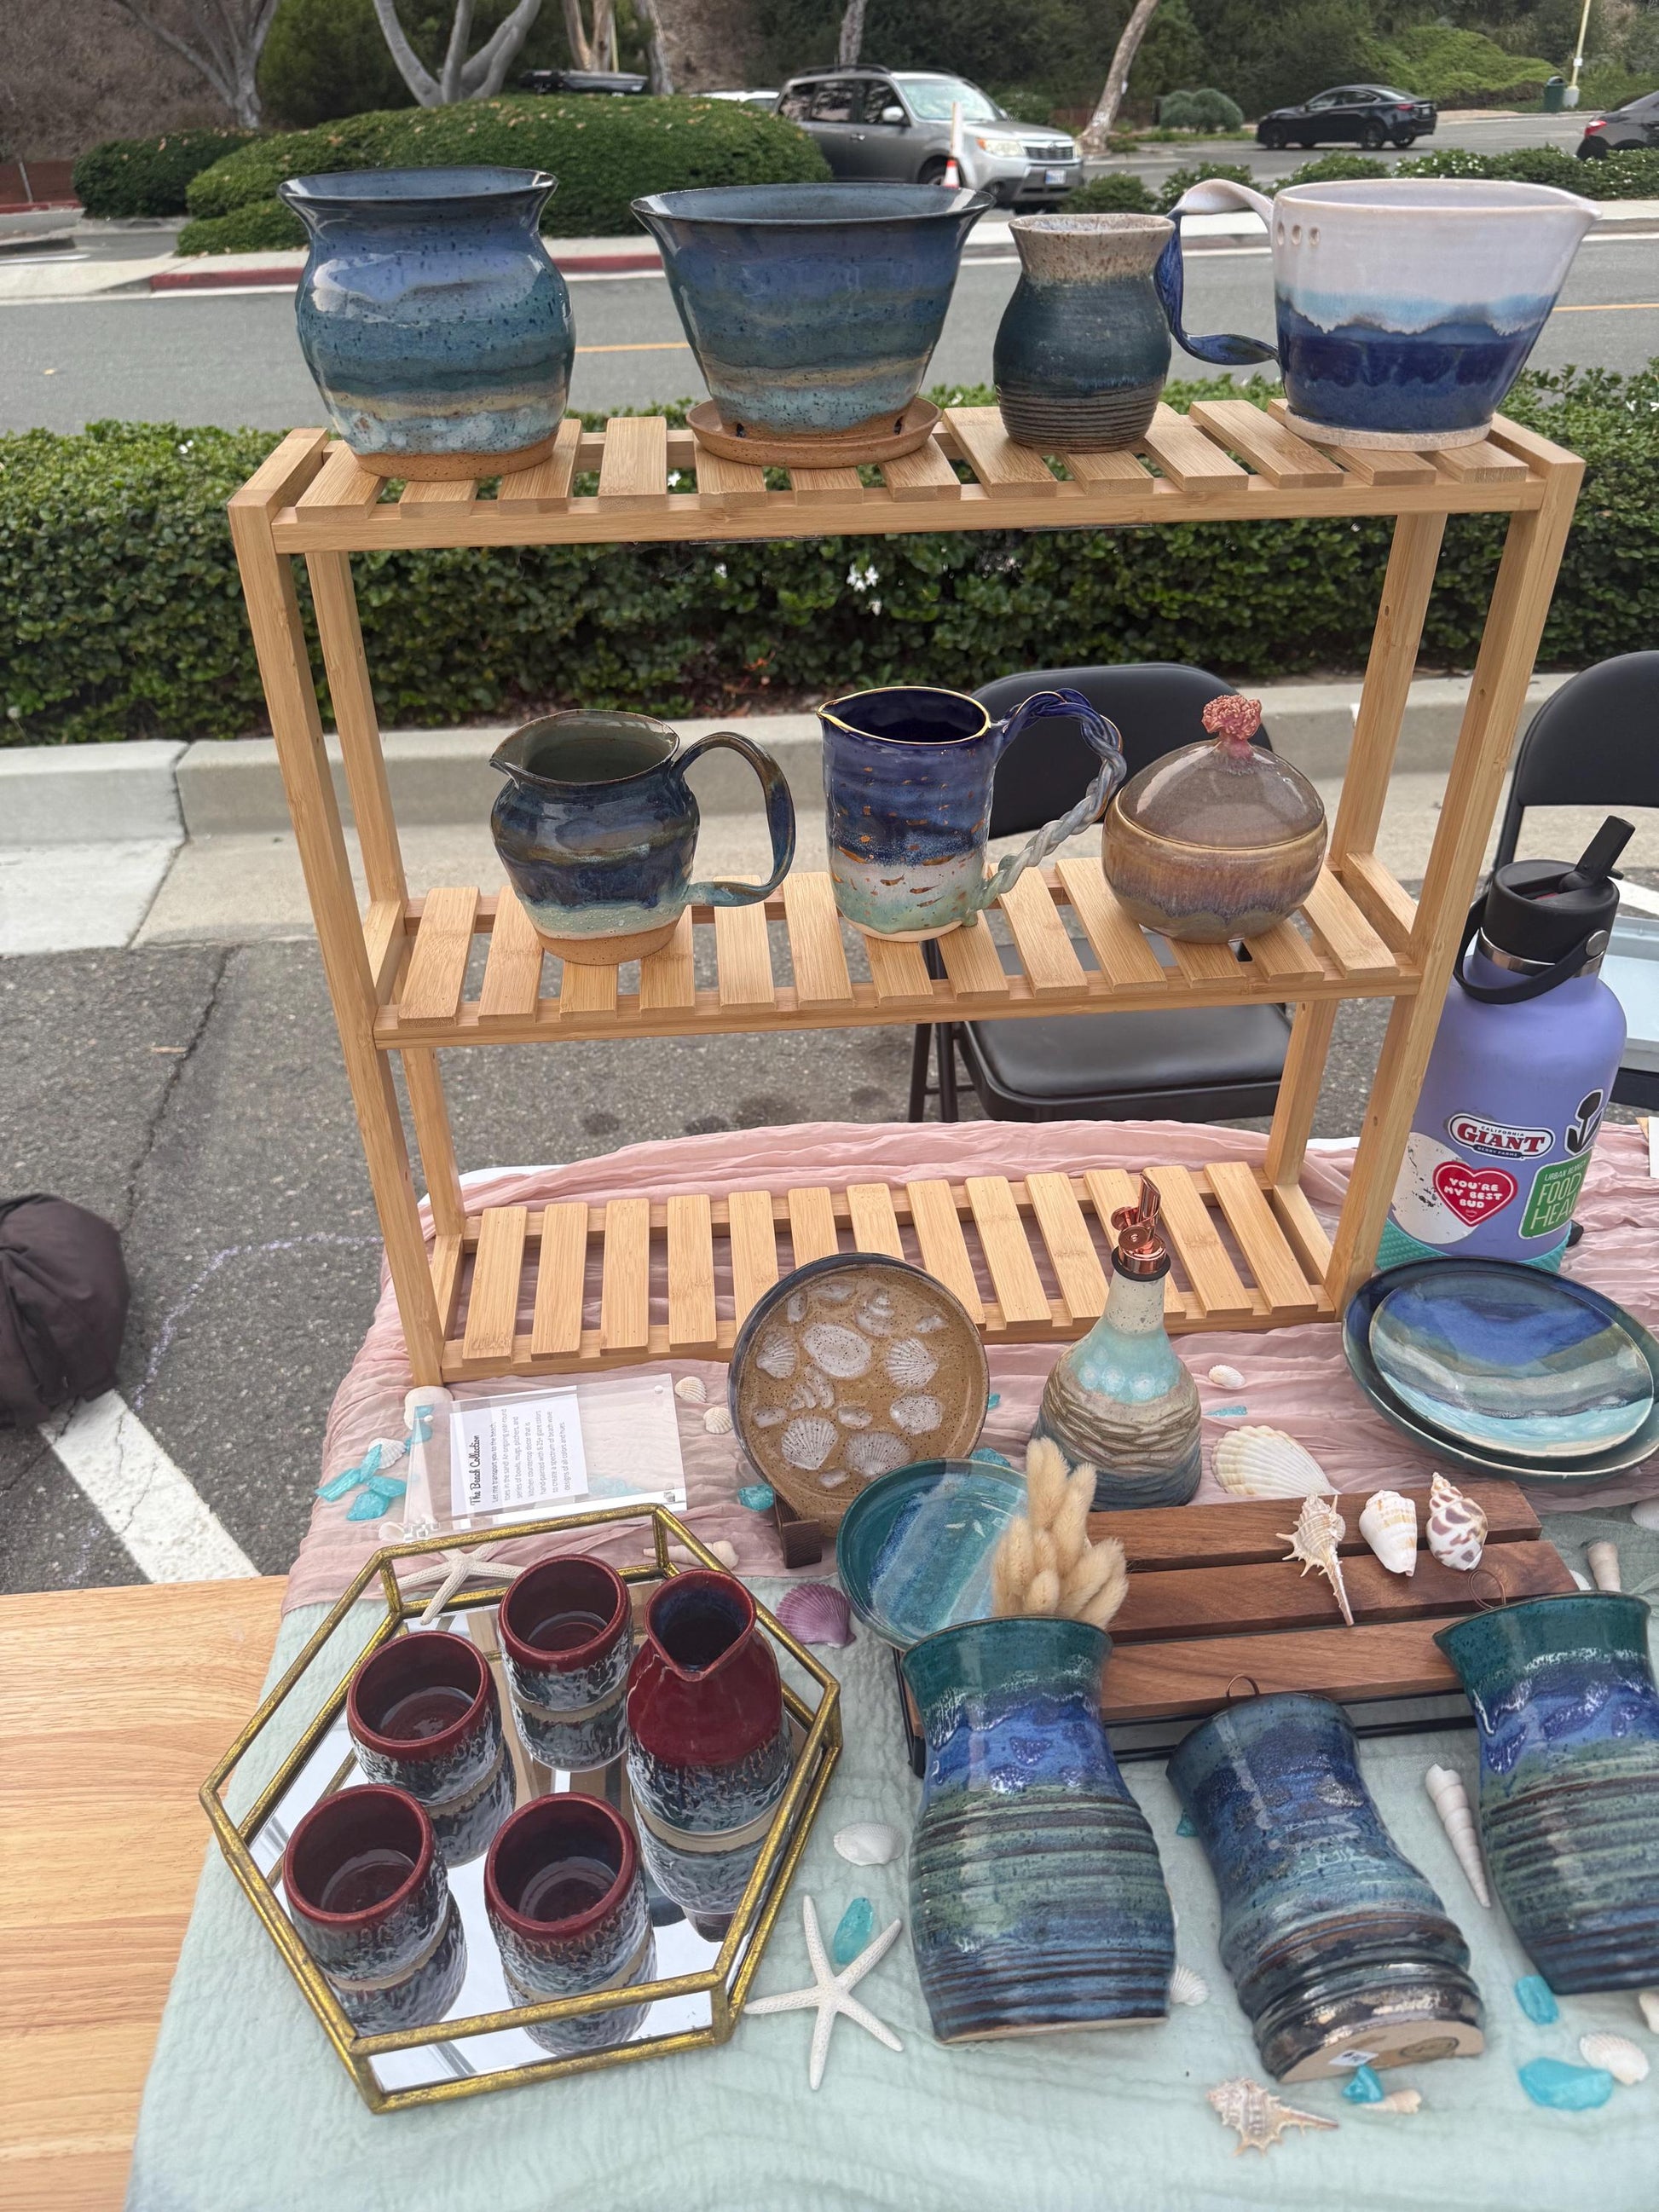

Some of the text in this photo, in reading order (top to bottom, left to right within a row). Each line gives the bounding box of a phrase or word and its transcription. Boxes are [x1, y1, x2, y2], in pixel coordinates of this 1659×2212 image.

[1457, 1123, 1546, 1152] GIANT
[1481, 1126, 1524, 1136] CALIFORNIA
[1444, 1186, 1503, 1200] MY BEST
[1449, 1177, 1499, 1192] YOU'RE
[1537, 1173, 1582, 1206] FOOD
[1460, 1199, 1485, 1208] BUD
[525, 1450, 535, 1477] countertop
[548, 1443, 557, 1465] spectrum
[469, 1435, 481, 1505] The Beach Collection
[490, 1461, 499, 1484] transport
[493, 1485, 498, 1493] me
[563, 1471, 572, 1490] designs
